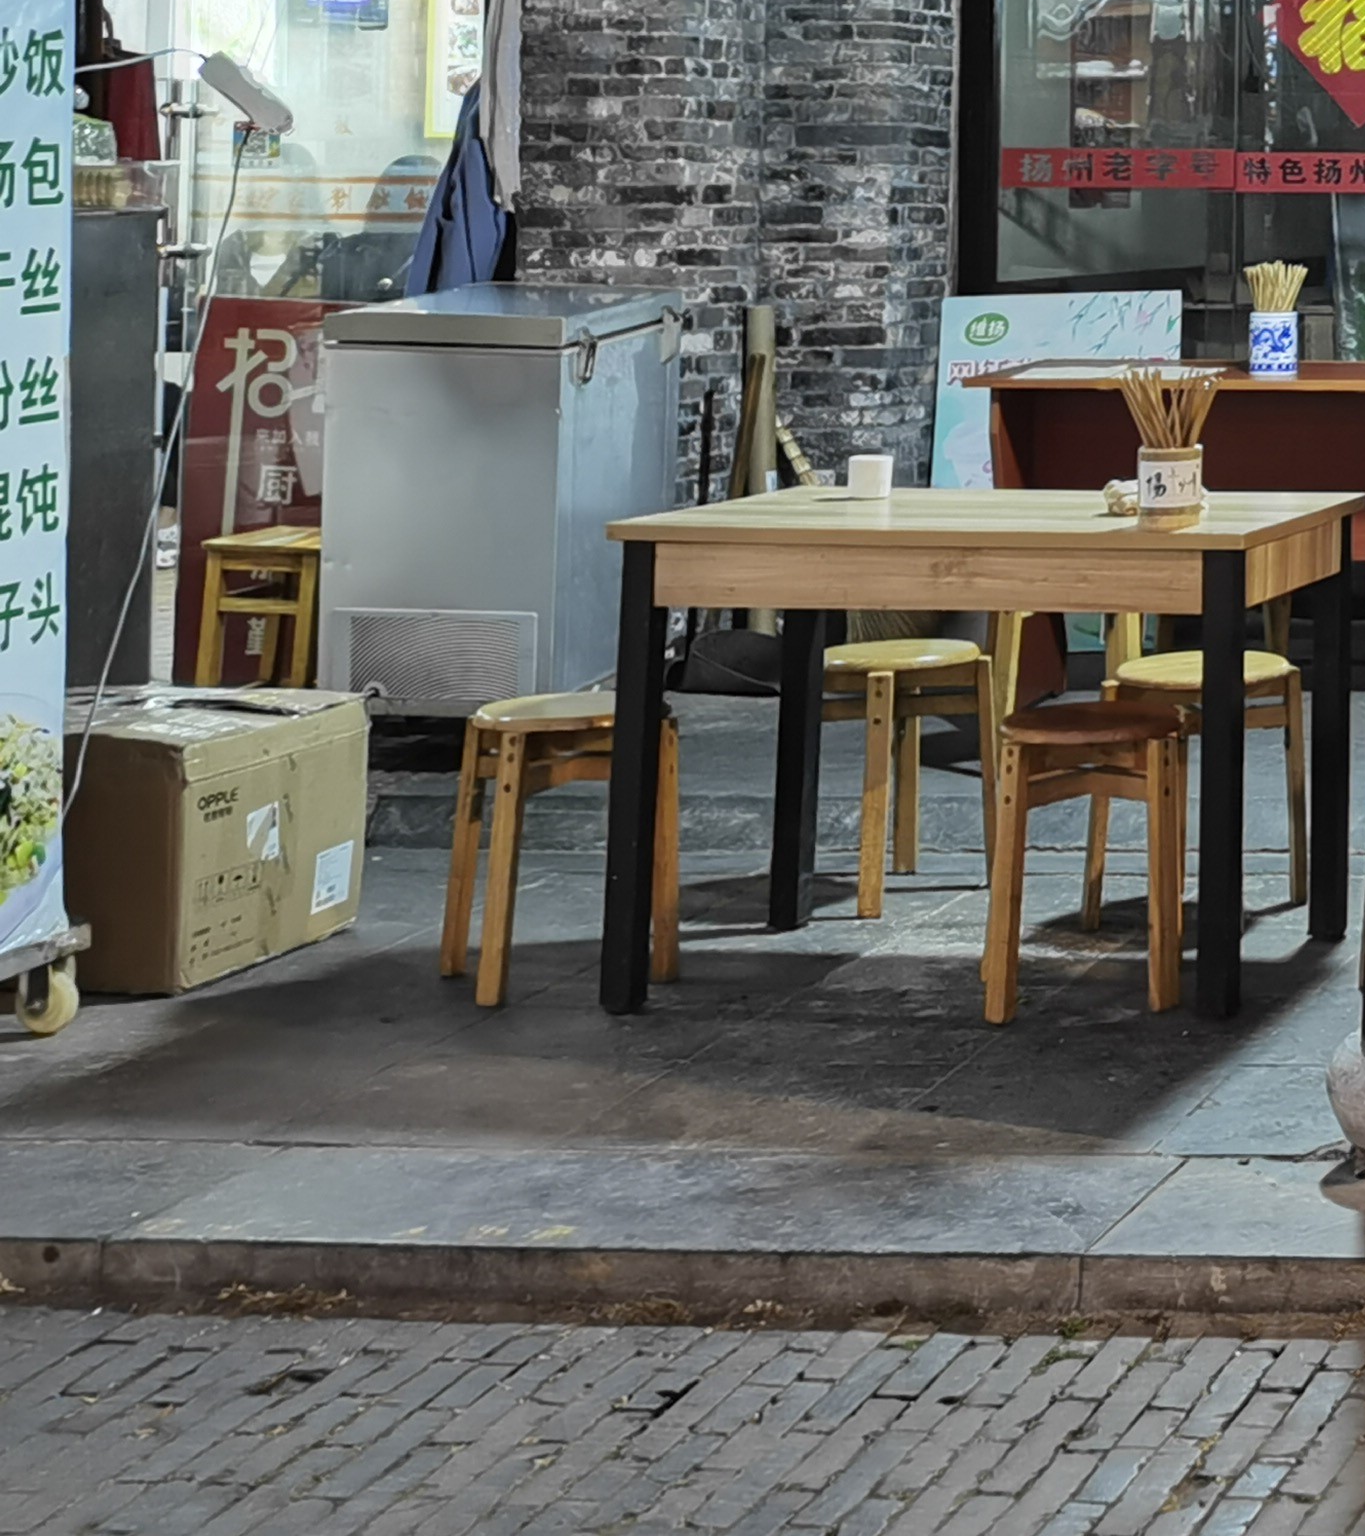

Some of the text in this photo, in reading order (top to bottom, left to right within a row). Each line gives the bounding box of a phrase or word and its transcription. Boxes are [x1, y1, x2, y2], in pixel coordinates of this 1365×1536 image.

[1018, 152, 1218, 184] 扬州老字号
[196, 786, 241, 812] OPPLE
